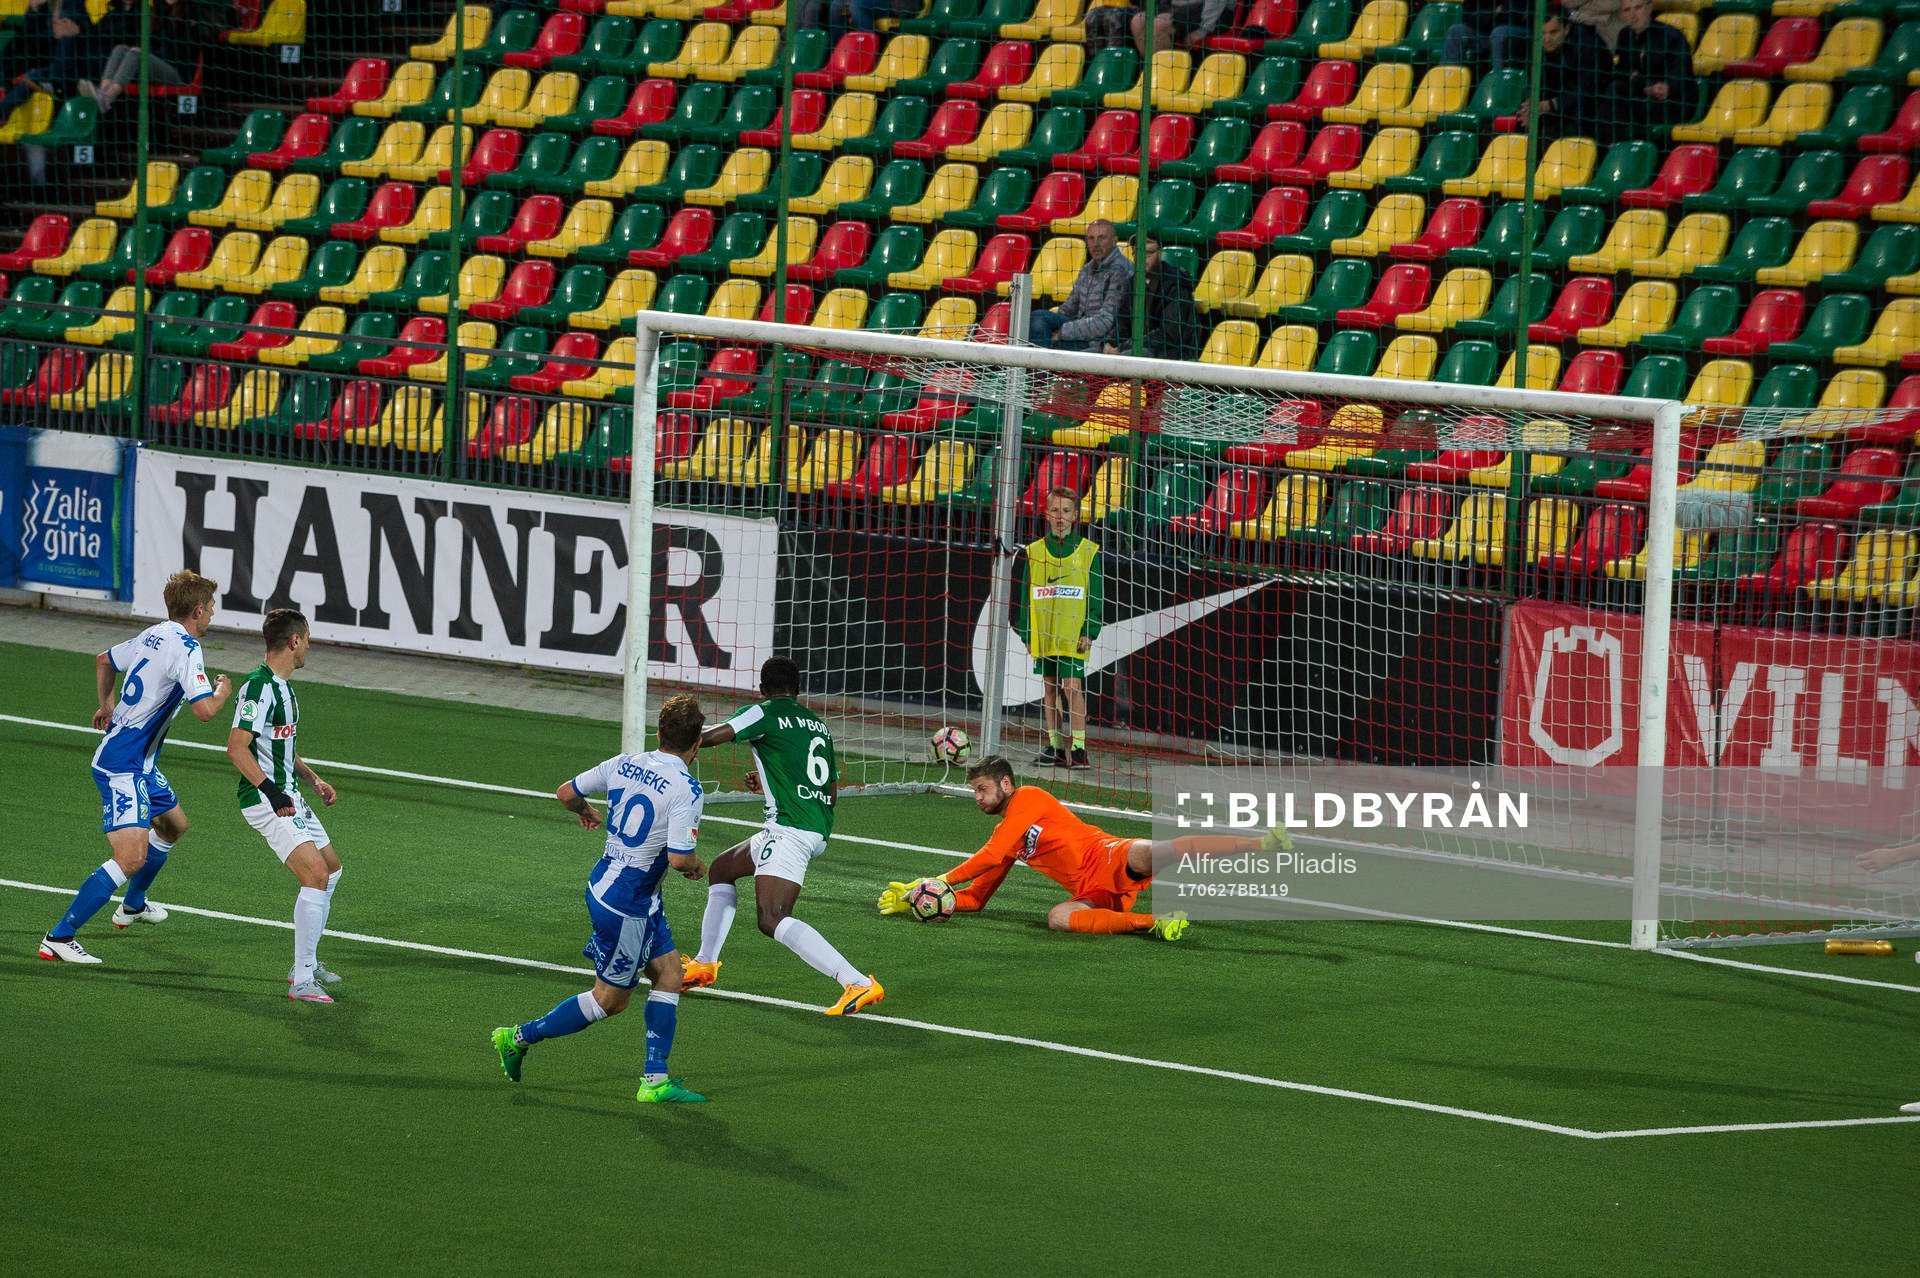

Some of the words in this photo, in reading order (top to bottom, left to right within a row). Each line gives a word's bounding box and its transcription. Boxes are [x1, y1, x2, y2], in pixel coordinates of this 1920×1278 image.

[287, 47, 296, 60] 7
[184, 97, 193, 111] 6
[79, 148, 89, 161] 5
[42, 480, 102, 525] Žalia
[44, 523, 100, 560] giria
[175, 470, 732, 670] HANNER
[122, 657, 150, 706] 6
[618, 762, 671, 795] SERNEKE
[806, 736, 829, 786] 6
[607, 787, 655, 848] 10
[760, 840, 776, 860] 6
